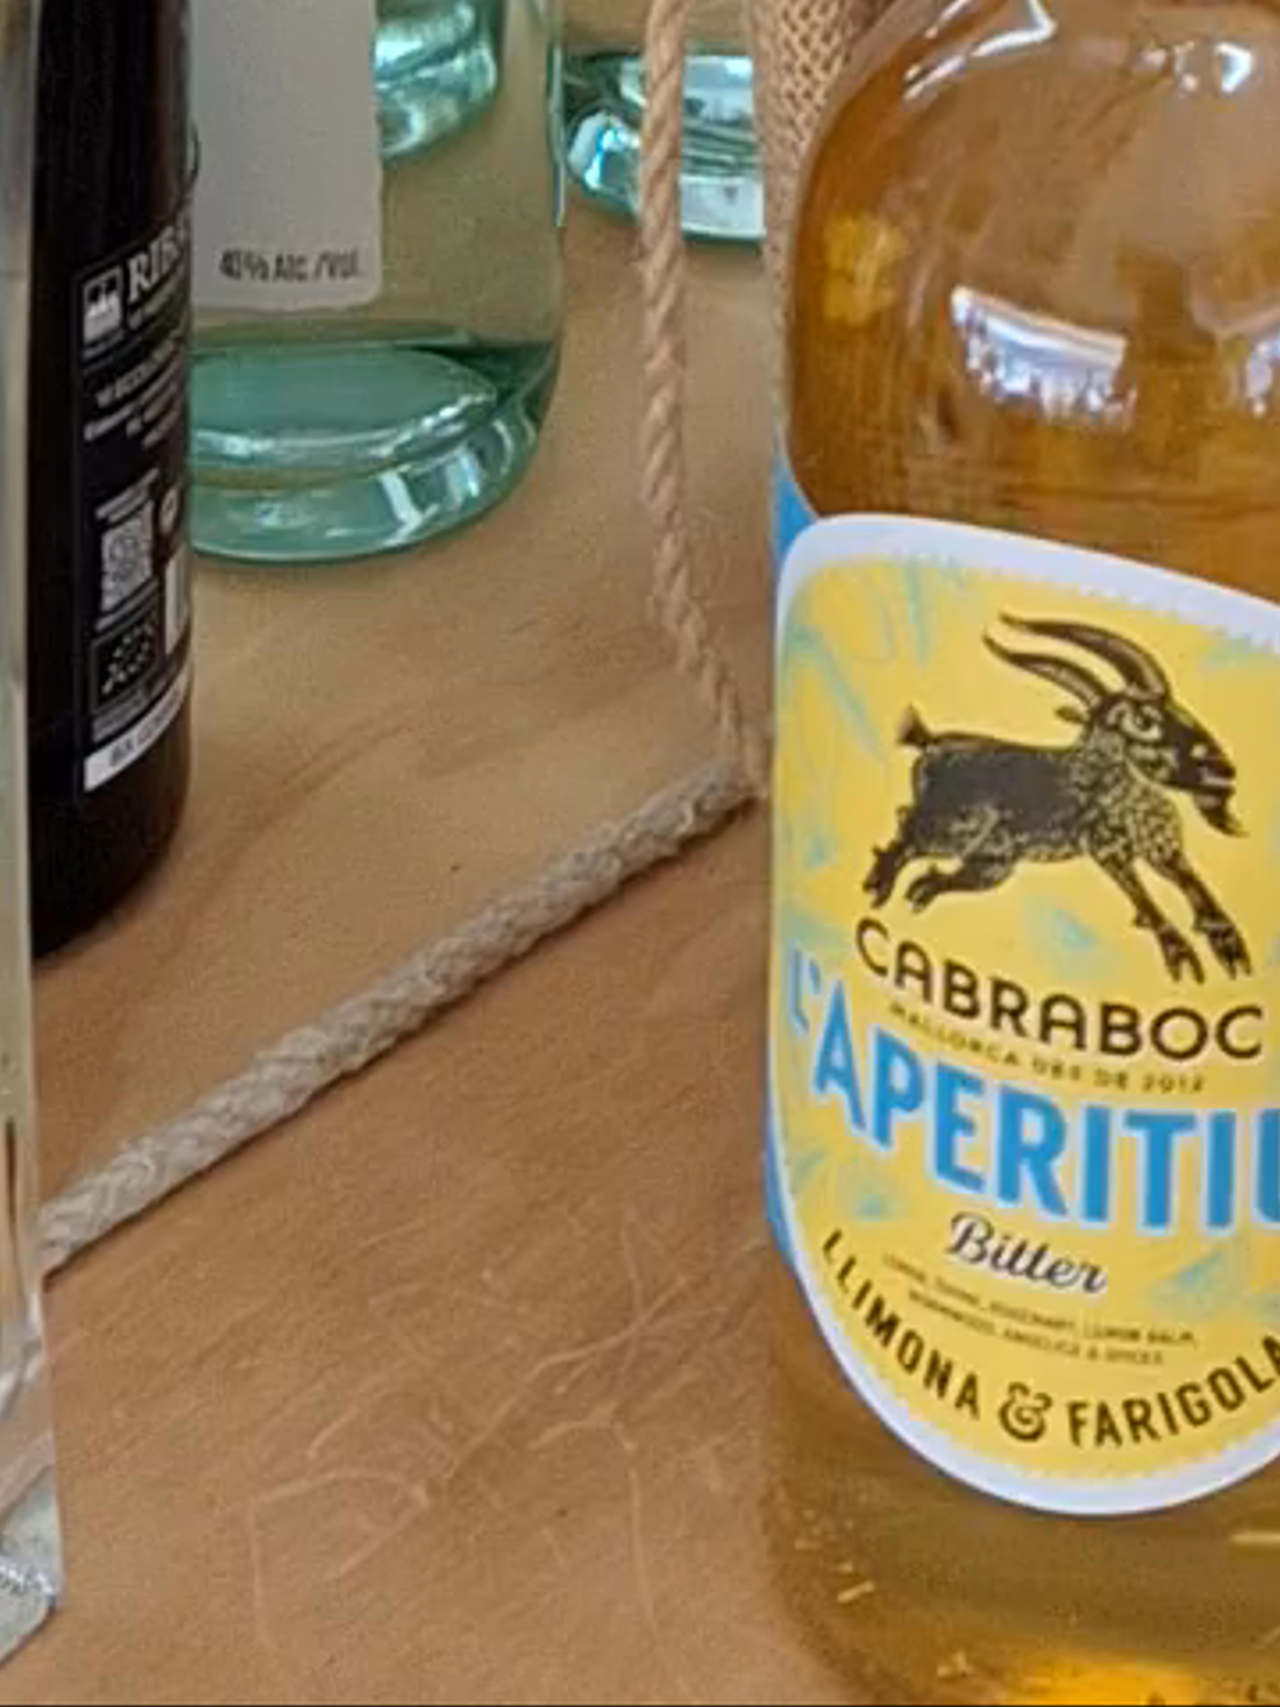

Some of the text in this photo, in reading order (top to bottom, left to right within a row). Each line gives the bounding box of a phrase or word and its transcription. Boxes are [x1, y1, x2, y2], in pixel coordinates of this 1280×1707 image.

[854, 916, 1265, 1061] CABRABOC
[889, 1001, 1019, 1068] MALLORCA
[1094, 1068, 1129, 1091] DE
[1141, 1072, 1207, 1095] 2012
[946, 1210, 1108, 1295] Bitter
[821, 1226, 982, 1421] LLIMONA
[997, 1381, 1054, 1443] &
